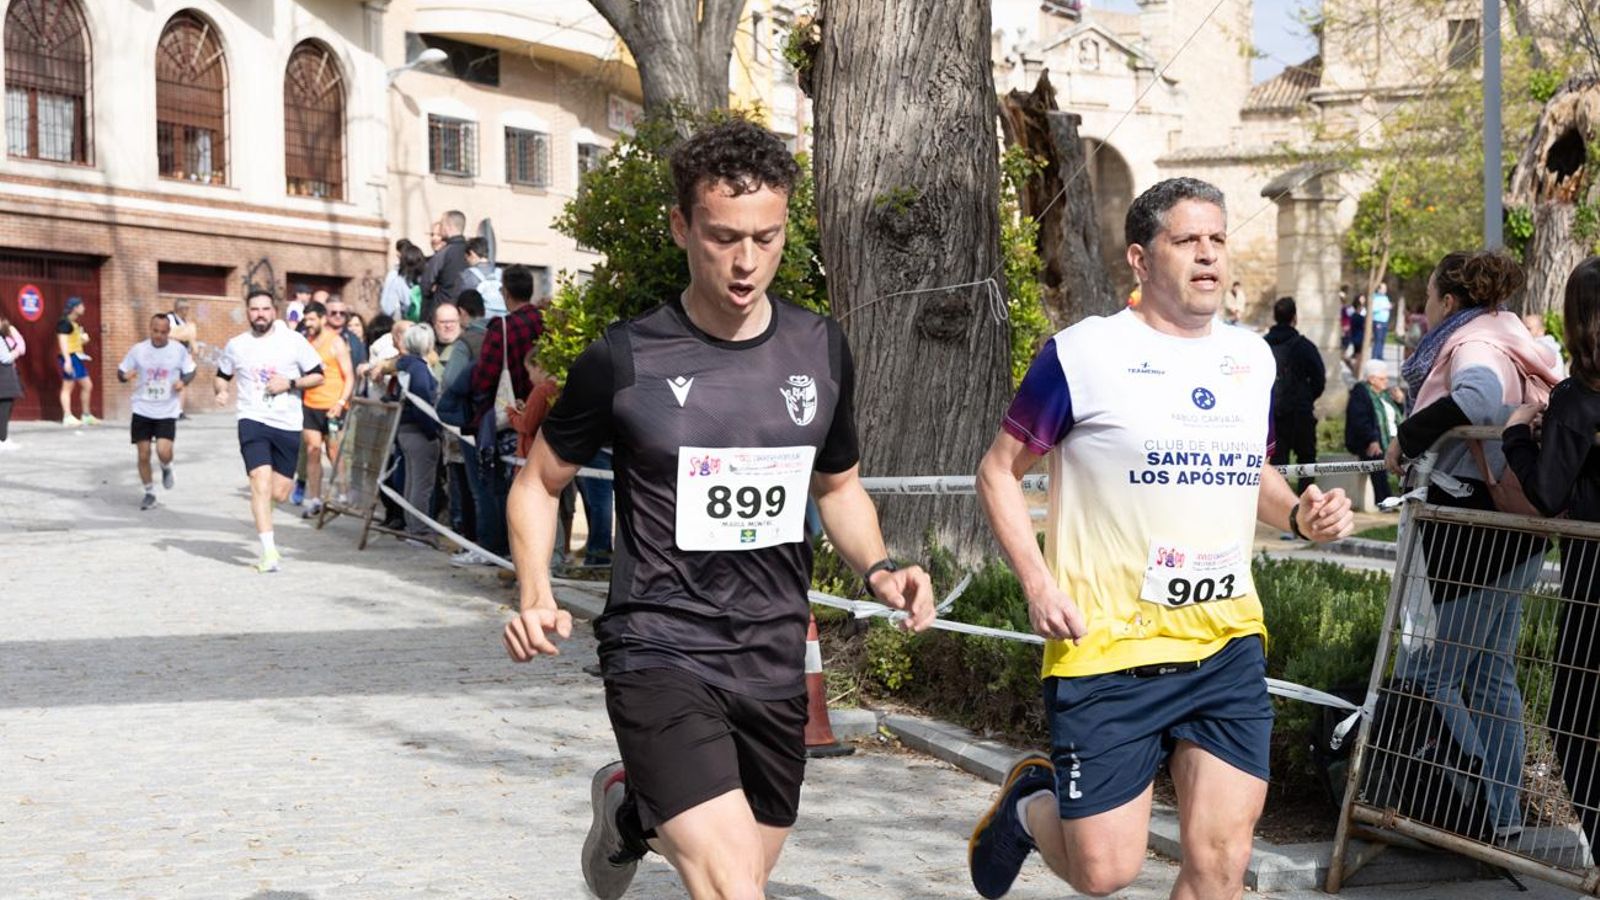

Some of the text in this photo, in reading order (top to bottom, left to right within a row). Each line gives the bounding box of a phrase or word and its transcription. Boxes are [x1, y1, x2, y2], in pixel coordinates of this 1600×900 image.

[1144, 439, 1184, 451] CLUB
[1189, 440, 1206, 451] DE
[1147, 452, 1263, 468] SANTA Mª DE
[1130, 470, 1170, 484] LOS
[1176, 468, 1261, 487] APÓSTOLE
[706, 485, 786, 519] 899
[1167, 574, 1235, 606] 903
